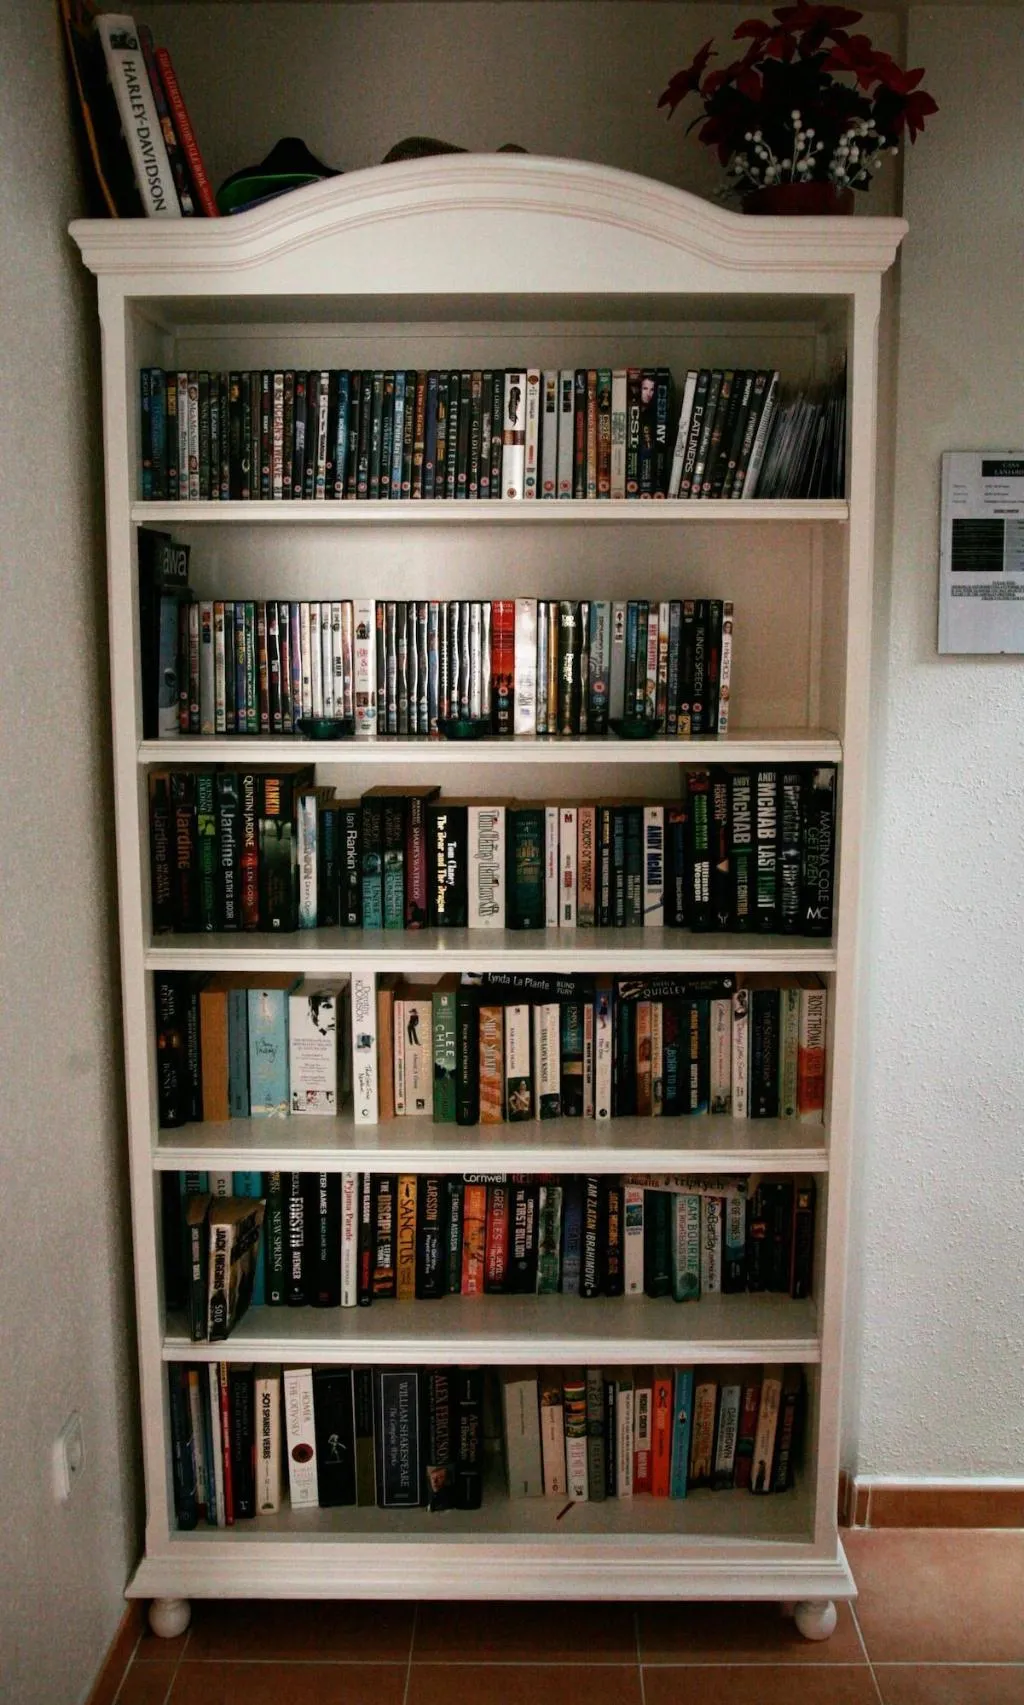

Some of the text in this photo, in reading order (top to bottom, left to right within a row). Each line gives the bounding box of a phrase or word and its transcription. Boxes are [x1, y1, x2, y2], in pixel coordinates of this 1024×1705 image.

[122, 60, 167, 211] HARLEY-DAVIDSON
[471, 420, 480, 473] GLADIATOR
[656, 424, 667, 444] NY
[685, 406, 703, 473] FLATLINERS
[659, 642, 668, 683] BLITZ
[693, 663, 704, 696] SPEECH
[243, 775, 255, 811] QUINTIN
[265, 779, 281, 816] RANKIN
[757, 783, 777, 840] McNAB
[154, 810, 167, 861] Jardine
[176, 809, 193, 869] Jardine
[243, 813, 255, 848] JARDINE
[346, 813, 358, 869] Ian Rankin
[479, 810, 500, 830] Tom
[220, 809, 236, 920] Jardine DEATH'S DOOR
[436, 815, 447, 913] The Bear and The Dragon
[446, 841, 458, 886] Tom Clancy
[647, 826, 662, 885] ANDY McNAB
[732, 788, 750, 917] McNAB CONTROL
[758, 845, 776, 872] LAST
[808, 827, 819, 886] GET EVEN
[818, 811, 831, 902] MARTINA COLE
[479, 862, 500, 901] Rainbow
[694, 861, 702, 902] Weapon
[702, 861, 710, 903] Ultimate
[757, 876, 776, 909] LIGHT
[479, 901, 500, 917] Six
[355, 980, 364, 1022] KOOMSON
[488, 972, 550, 991] Lynda La Plante
[556, 980, 576, 989] BLIND
[557, 987, 574, 997] FURY
[540, 1028, 548, 1043] THE
[807, 995, 823, 1049] ROSIE THOMAS
[435, 1024, 444, 1064] CHILD
[540, 1043, 548, 1061] LOVE
[463, 1172, 507, 1184] Cornwell
[588, 1183, 598, 1197] AM
[319, 1190, 327, 1214] JAMES
[344, 1180, 354, 1242] Pyjama Parade
[377, 1181, 392, 1243] THE DISCIPLE
[426, 1180, 438, 1220] LARSSON
[492, 1189, 504, 1241] GREG ILES
[515, 1203, 526, 1226] FIRST
[586, 1199, 598, 1230] ZLATAN
[271, 1211, 283, 1272] NEW SPRING
[288, 1197, 304, 1280] FORSYTH AVENGER
[400, 1199, 415, 1265] SANCTUS
[450, 1198, 459, 1252] ENGLISH ASSASSIN
[514, 1228, 525, 1258] BILLION
[687, 1198, 699, 1271] SAM BOURNE
[214, 1228, 226, 1323] JACK HIGGINS SOLO
[435, 1376, 449, 1404] ALEX
[263, 1393, 271, 1459] 501 SPANISH VERBS
[399, 1382, 410, 1488] WILLIAM SHAKESPEARE
[724, 1427, 735, 1459] BROWN
